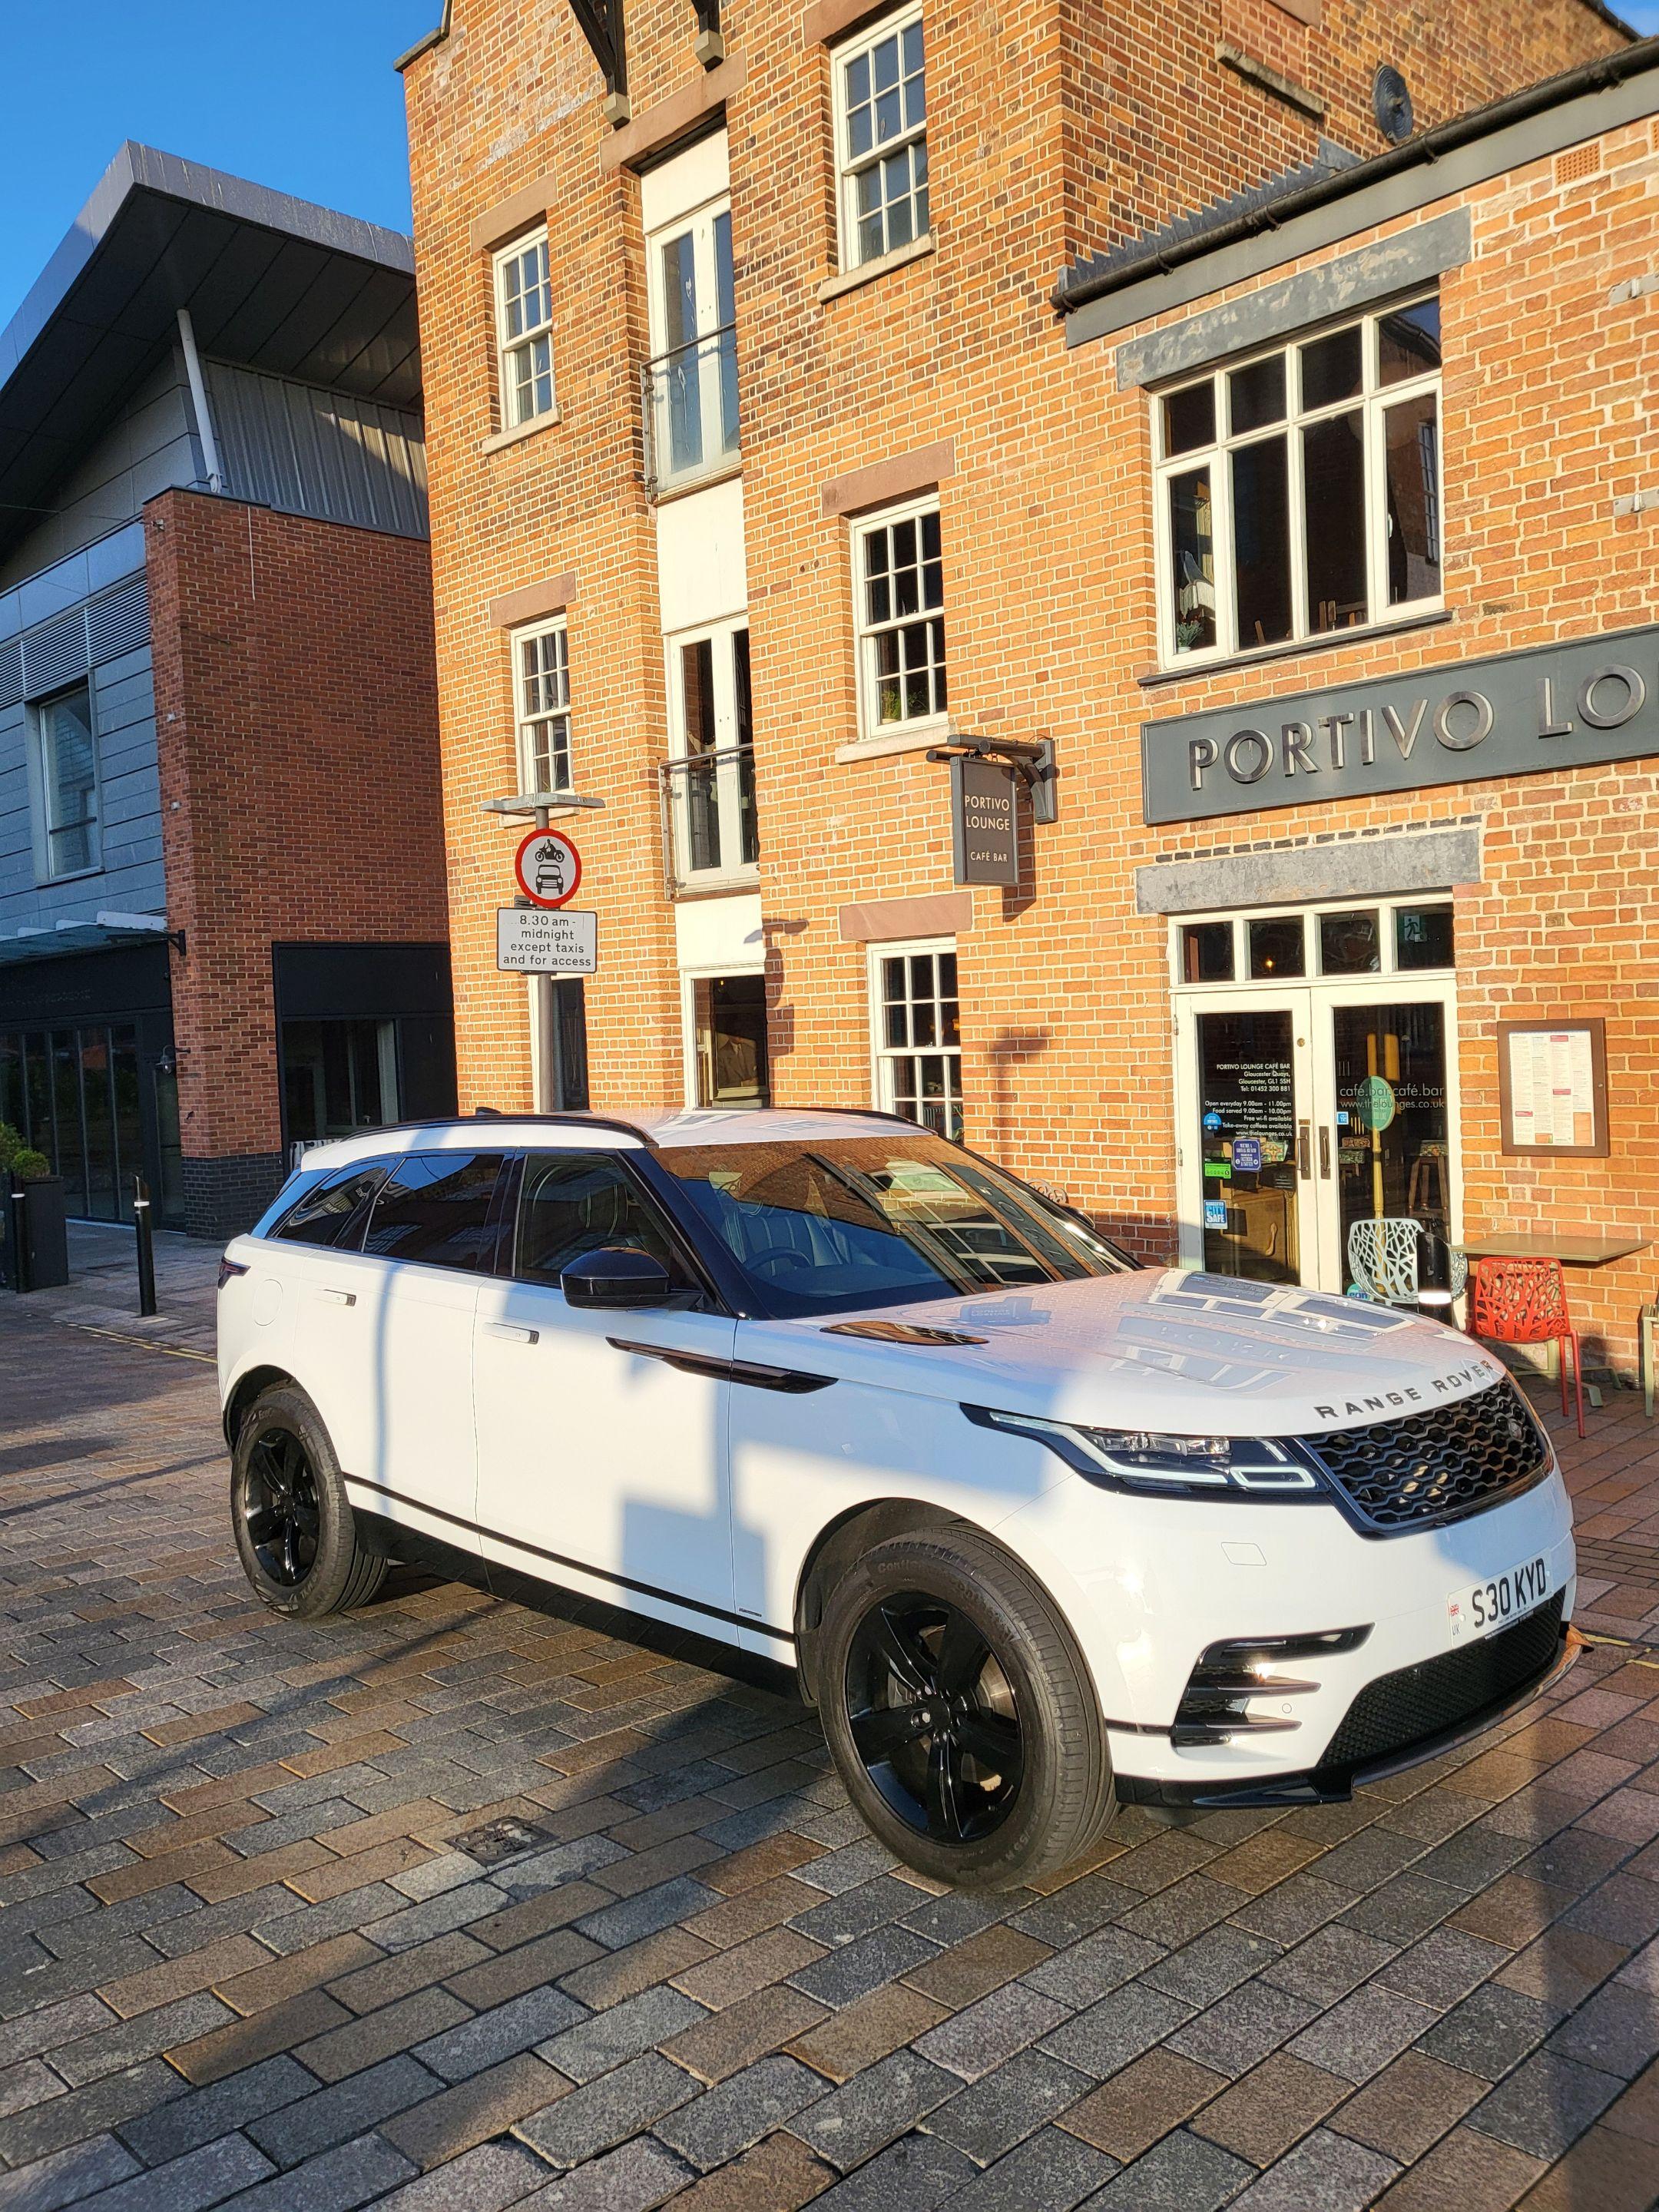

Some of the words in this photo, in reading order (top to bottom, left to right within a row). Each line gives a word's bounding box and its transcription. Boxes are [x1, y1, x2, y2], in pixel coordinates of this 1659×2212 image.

[1190, 690, 1494, 790] PORTIVO
[965, 795, 1010, 811] PORTIVO
[966, 816, 1010, 830] LOUNGE
[971, 850, 990, 861] CAFÉ
[993, 853, 1008, 862] BAR
[519, 915, 548, 926] 8.30
[521, 929, 575, 941] midnight
[510, 942, 551, 953] except
[556, 943, 584, 953] taxis
[503, 955, 525, 964] and
[530, 955, 547, 965] for
[551, 958, 591, 966] access
[1313, 1387, 1422, 1419] RANGE
[1430, 1359, 1494, 1392] ROVER
[1472, 1577, 1512, 1629] S30
[1514, 1558, 1546, 1609] KYD
[1452, 1624, 1460, 1636] UK
